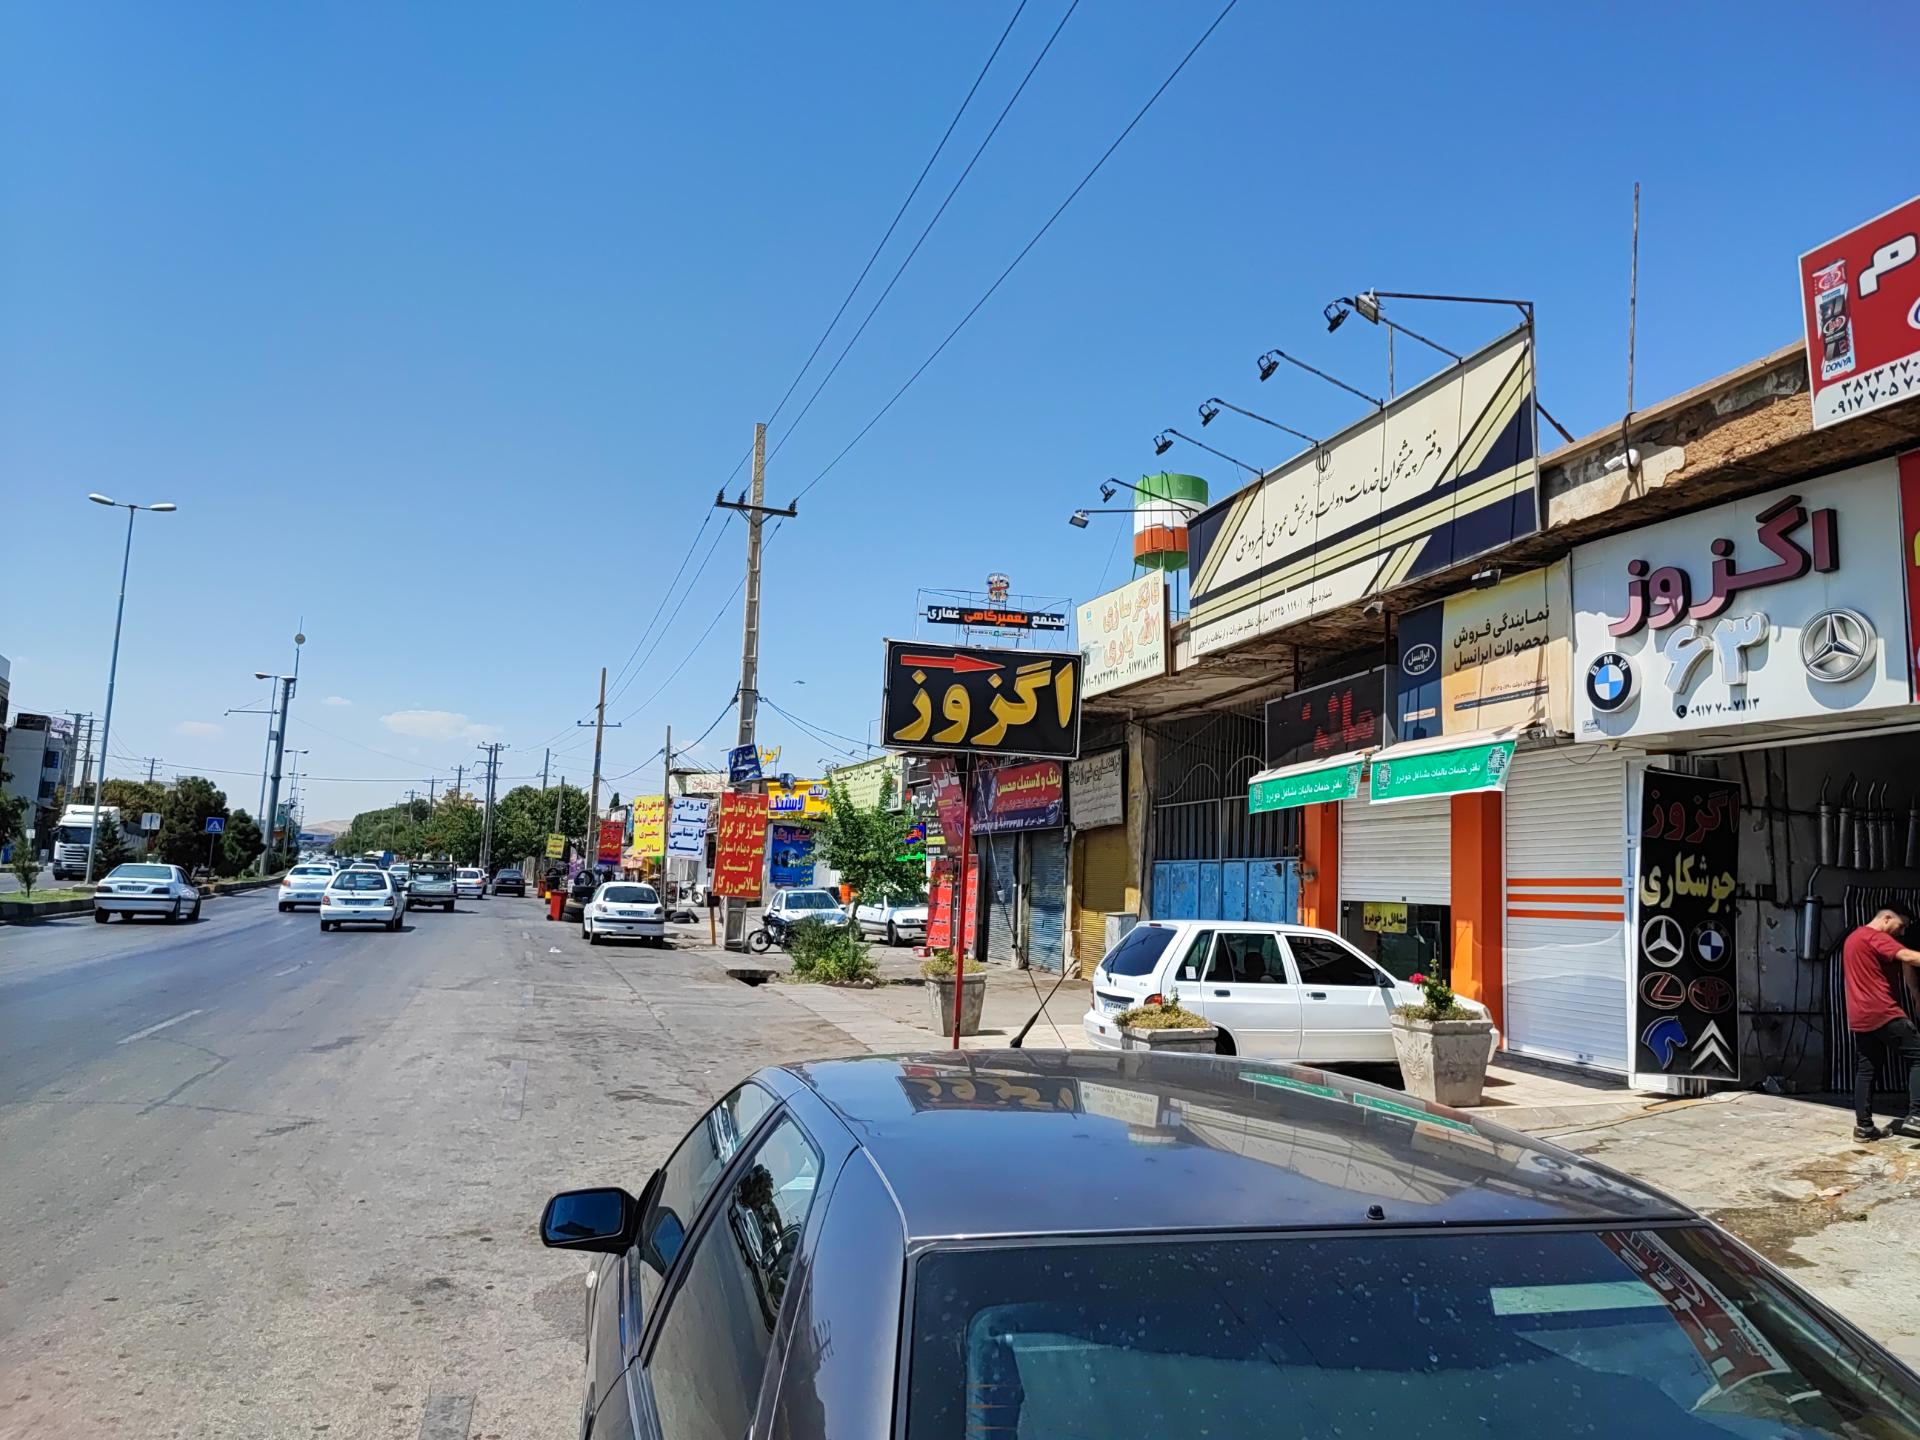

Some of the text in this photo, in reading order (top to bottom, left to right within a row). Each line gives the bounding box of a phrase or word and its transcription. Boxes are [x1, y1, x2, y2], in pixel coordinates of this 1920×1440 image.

[1825, 357, 1852, 374] DONYA
[1841, 368, 1884, 396] ۳۸۲۳
[1831, 394, 1864, 414] ۰۹۱۷
[1869, 382, 1899, 402] ۷۰۵
[1416, 430, 1442, 475] دفتر
[1379, 439, 1417, 492] پیشخوان
[1345, 467, 1379, 503] خدمات
[1315, 489, 1345, 518] دولت
[1289, 495, 1309, 536] بخش
[1608, 494, 1840, 638] اگزوز
[928, 606, 1066, 630] مجتمع تعمیرگاهی غفاری
[1454, 604, 1550, 648] نمایندگی فروش
[1408, 648, 1431, 666] ایرانسل
[1454, 634, 1549, 671] محصولات ایرانسل
[1664, 612, 1770, 694] ۶۳
[1589, 655, 1629, 677] BMW
[893, 660, 1074, 746] اگزوز
[1691, 704, 1712, 717] ۰۹۱۷
[1045, 767, 1062, 788] رینگ
[1412, 768, 1430, 782] مشاغل
[1448, 764, 1467, 776] خدمات
[1467, 762, 1480, 776] دفتر
[996, 780, 1017, 797] محسن
[1041, 776, 1046, 791] و
[1313, 782, 1330, 793] خدمات
[1395, 774, 1412, 785] خودرو
[808, 784, 828, 800] رینگ
[1265, 792, 1281, 803] خودرو
[1281, 786, 1297, 800] مشاغل
[769, 794, 804, 812] لاستیک
[1642, 789, 1740, 843] اگزوز
[670, 827, 706, 840] کارشناسی
[720, 821, 735, 838] کولر
[669, 841, 703, 856] رنگ
[722, 858, 753, 874] لاستیک
[734, 876, 760, 894] بالانس
[1640, 851, 1736, 913] جوشکاری
[1365, 911, 1382, 926] خودرو
